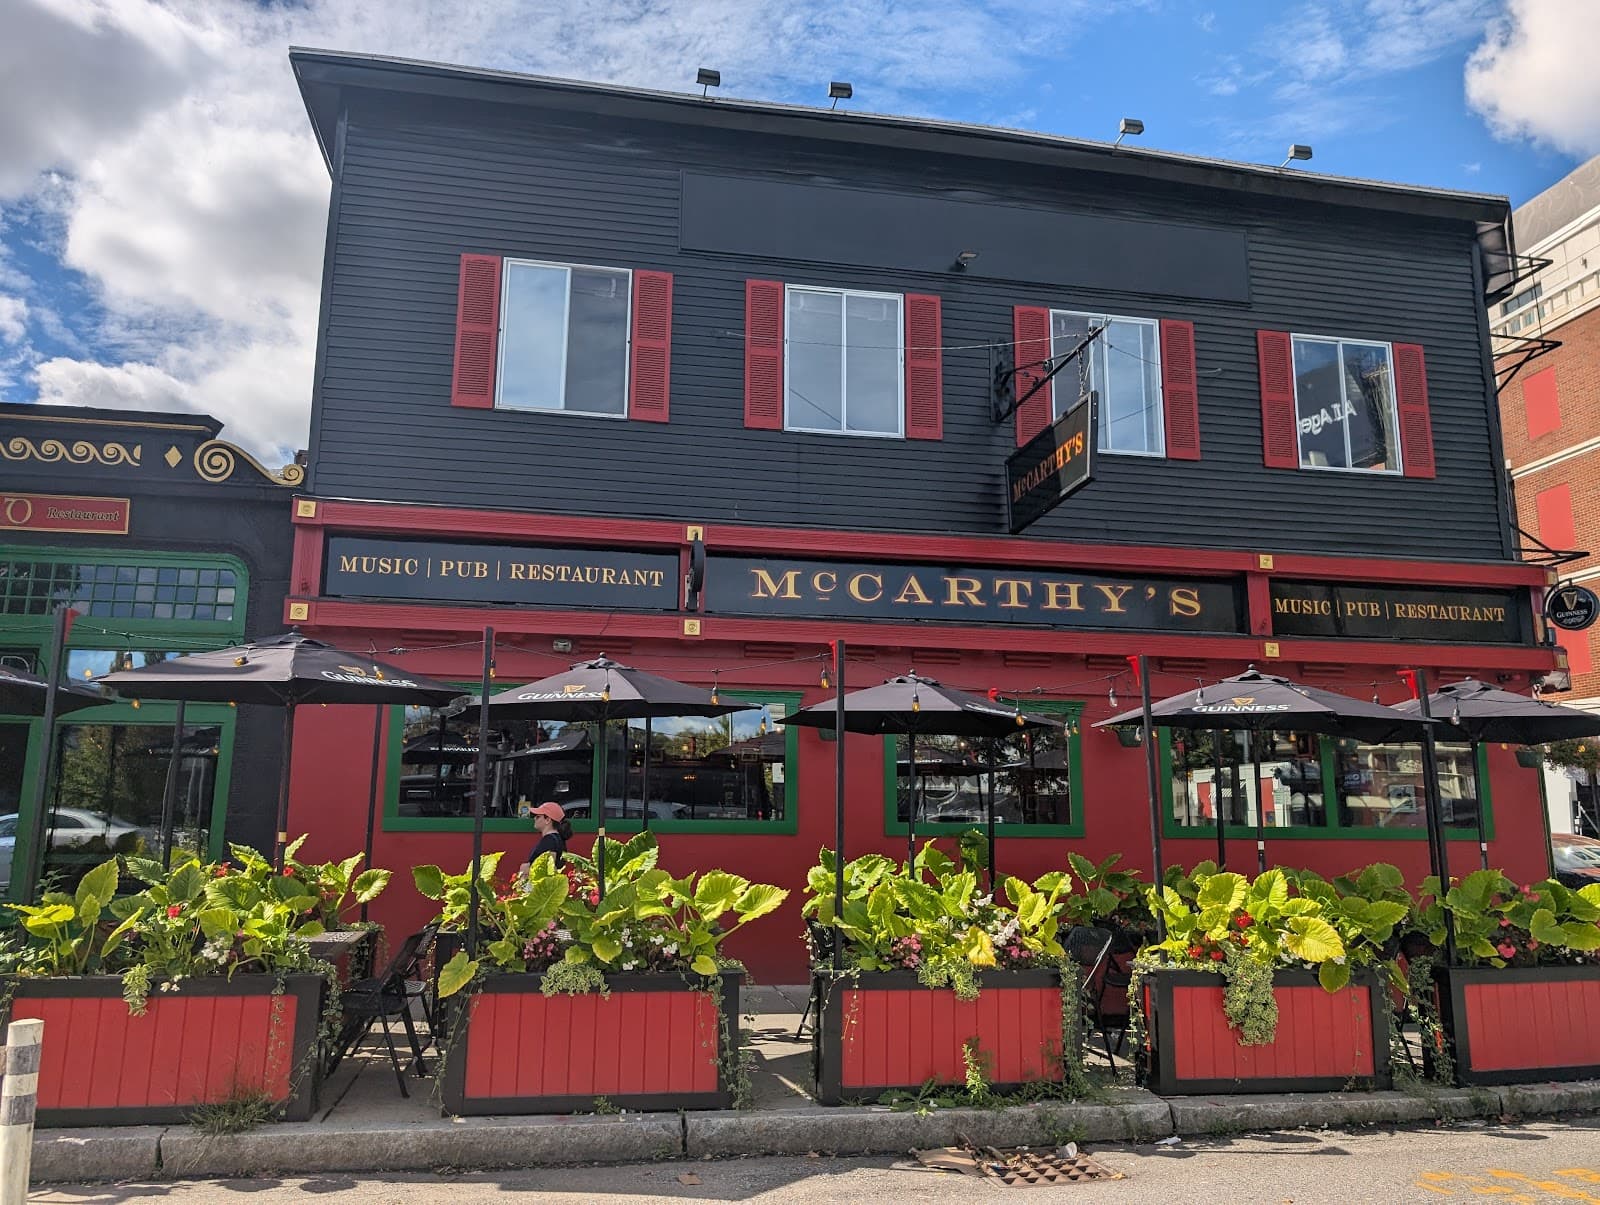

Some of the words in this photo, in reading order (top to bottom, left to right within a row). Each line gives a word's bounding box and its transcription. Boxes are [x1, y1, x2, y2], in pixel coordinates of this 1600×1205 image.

[47, 506, 120, 522] Restaurant
[340, 555, 418, 576] MUSIC
[440, 560, 488, 578] PUB
[509, 563, 664, 587] RESTAURANT
[1275, 598, 1331, 616] MUSIC
[1346, 601, 1381, 617] PUB
[1394, 603, 1505, 622] RESTAURANT
[1192, 705, 1290, 713] GUINNESS
